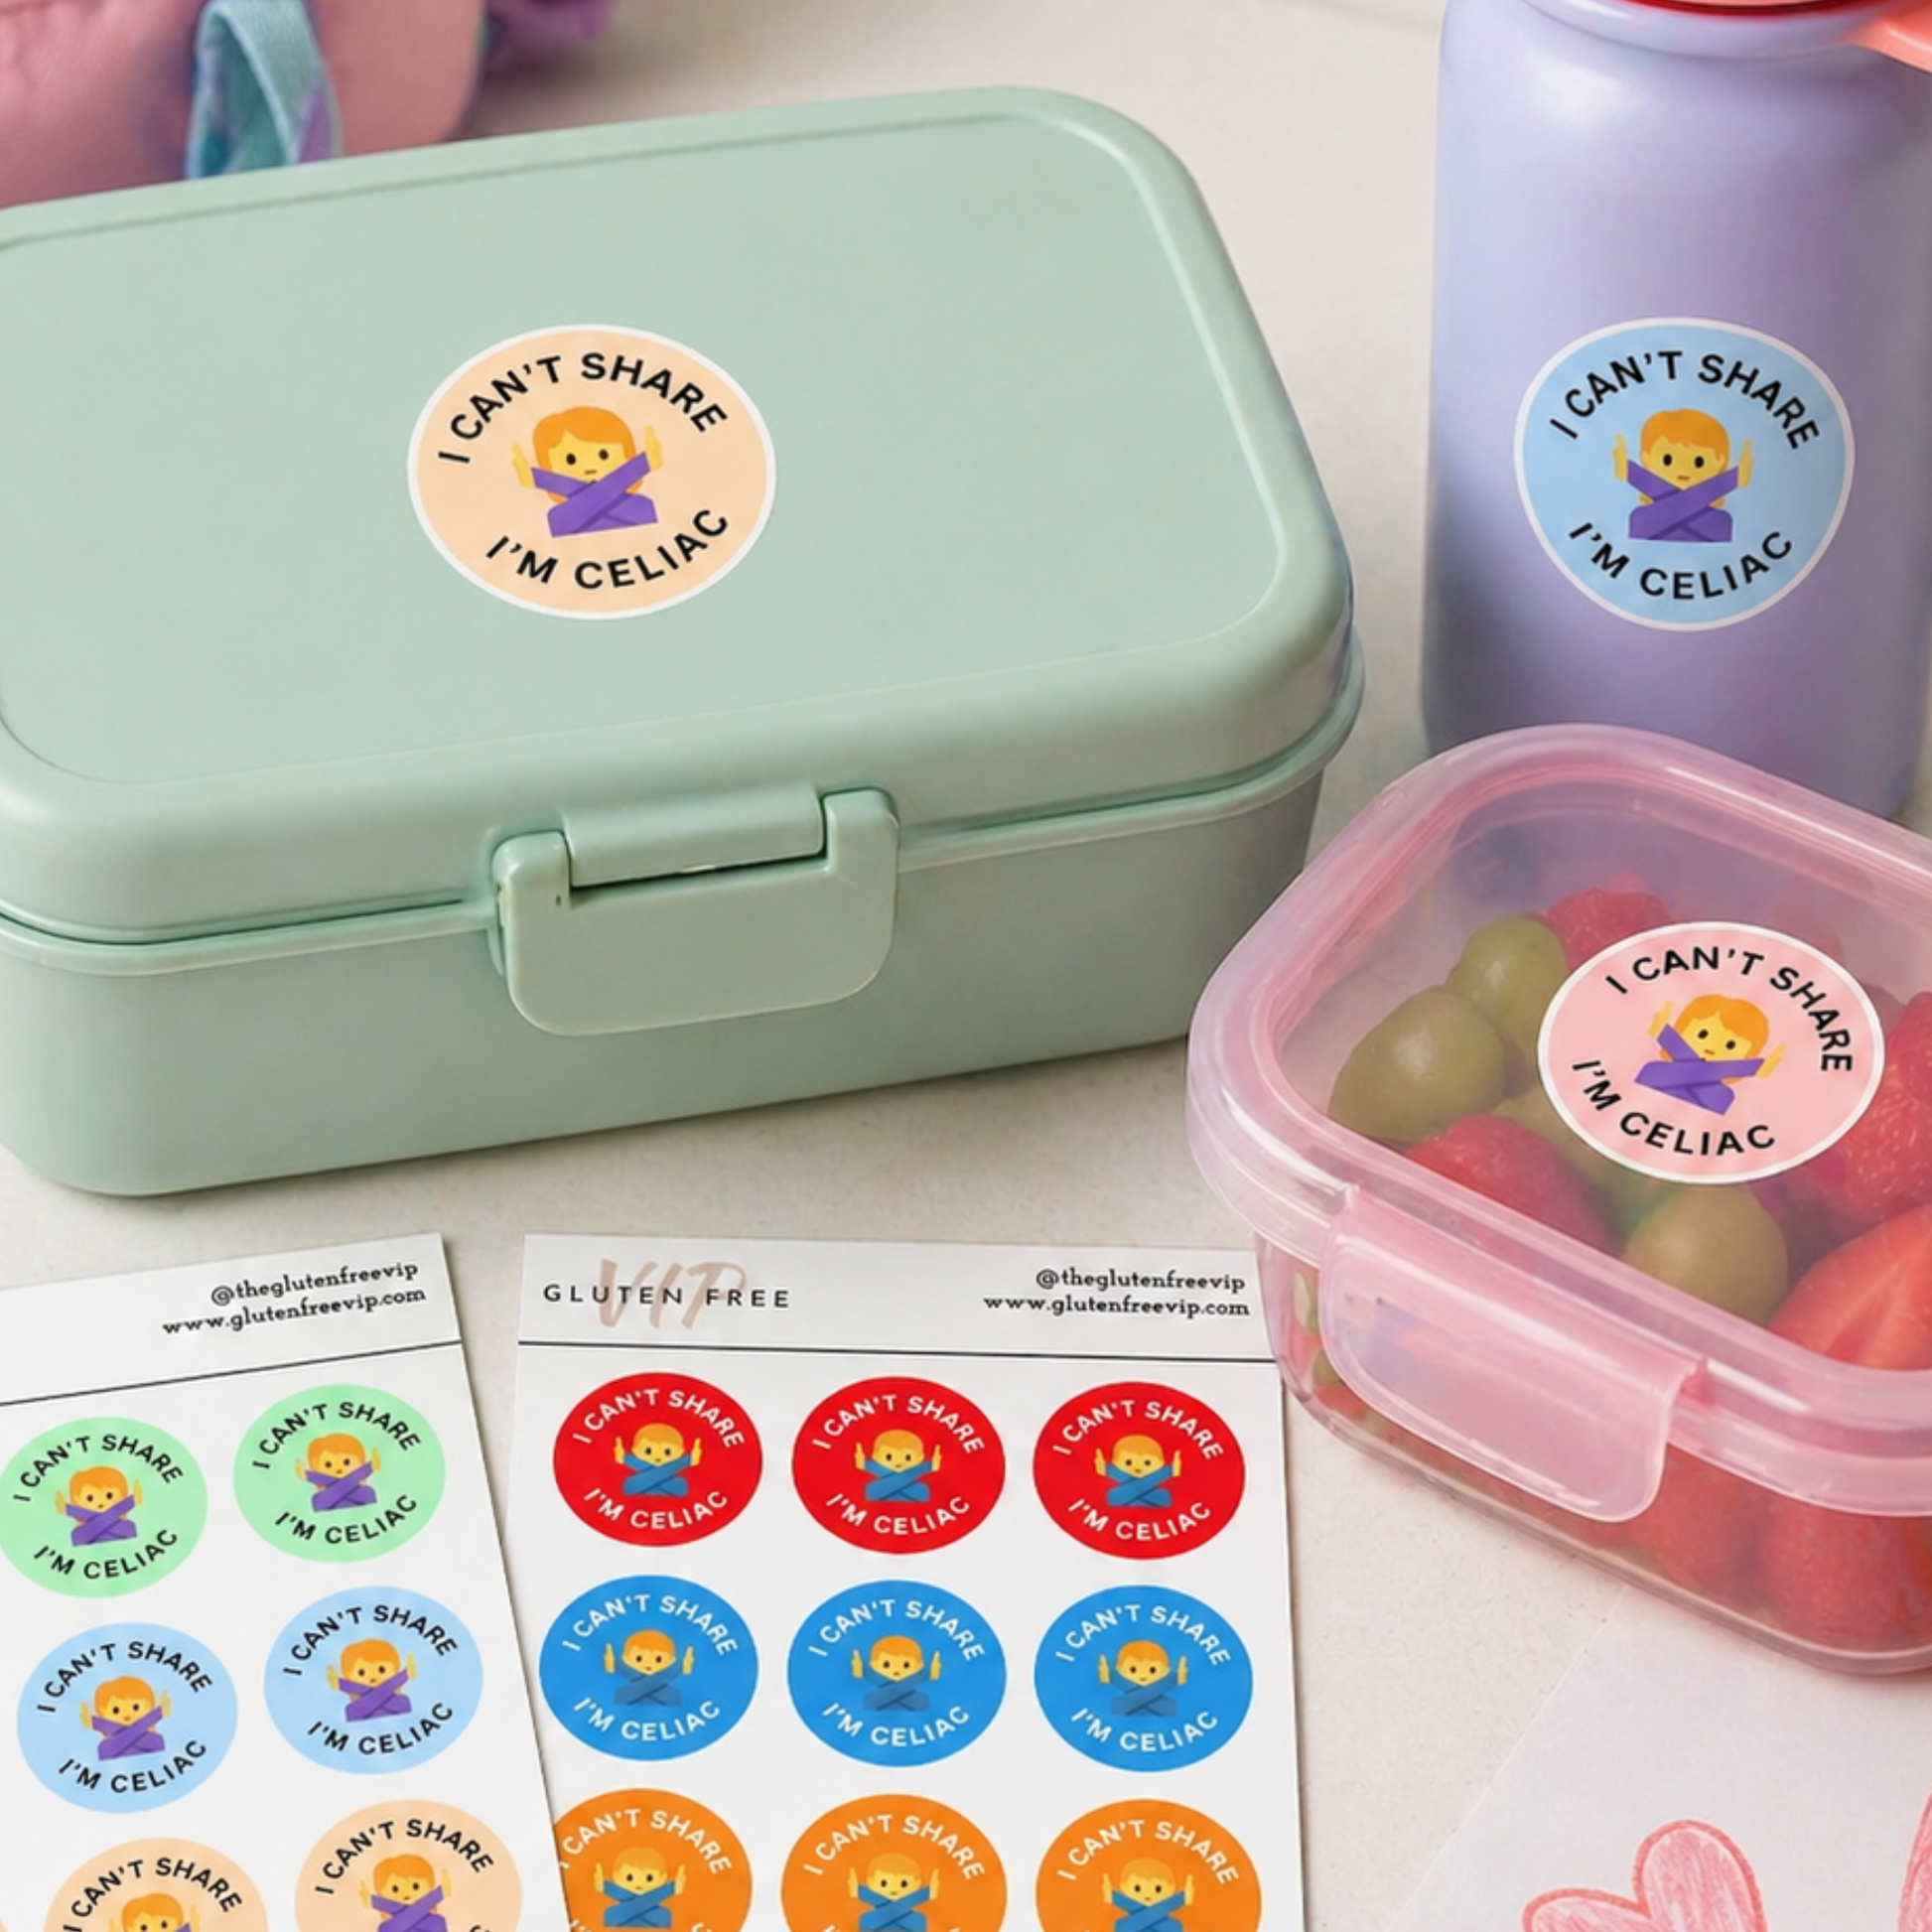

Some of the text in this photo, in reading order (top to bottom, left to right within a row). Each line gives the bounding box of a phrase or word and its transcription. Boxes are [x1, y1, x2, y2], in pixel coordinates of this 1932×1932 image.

[438, 352, 728, 464] I CAN'T SHARE
[1550, 350, 1820, 450] I CAN'T SHARE
[486, 509, 728, 590] I'M CELIAC
[1569, 522, 1792, 600] I'M CELIAC
[1605, 946, 1853, 1071] I CAN'T SHARE
[1573, 1060, 1774, 1156] I'M CELIAC
[211, 1261, 419, 1308] @theglutenfreevip
[543, 1283, 790, 1309] GLUTEN FREE
[599, 1258, 748, 1329] VIP
[983, 1294, 1250, 1319] www.glutenfreevip.com
[1035, 1266, 1246, 1294] @theglutenfreevip
[162, 1288, 427, 1334] www.glutenfreevip.com
[252, 1402, 421, 1469] I CAN'T SHARE
[573, 1388, 745, 1448] I CAN'T SHARE
[812, 1394, 985, 1453] I CAN'T SHARE
[1052, 1400, 1223, 1458] I CAN'T SHARE
[20, 1436, 89, 1487] CAN'T
[101, 1435, 183, 1483] SHARE
[275, 1495, 417, 1544] I'M CELIAC
[584, 1488, 728, 1530] I'M CELIAC
[826, 1493, 970, 1536] I'M CELIAC
[1068, 1498, 1211, 1541] I'M CELIAC
[34, 1530, 178, 1580] I'M CELIAC
[291, 1606, 361, 1660] CAN'T
[373, 1604, 458, 1655] SHARE
[562, 1593, 739, 1655] I CAN'T SHARE
[808, 1598, 985, 1661] I CAN'T SHARE
[1055, 1603, 1231, 1668] I CAN'T SHARE
[45, 1643, 115, 1698] CAN'T
[128, 1641, 212, 1692] SHARE
[308, 1704, 453, 1754] I'M CELIAC
[573, 1697, 720, 1741] I'M CELIAC
[822, 1703, 970, 1747] I'M CELIAC
[1070, 1708, 1218, 1752] I'M CELIAC
[59, 1740, 207, 1793] I'M CELIAC
[323, 1821, 393, 1879] CAN'T
[406, 1819, 493, 1872] SHARE
[563, 1808, 639, 1855] CAN'T
[651, 1810, 732, 1873] SHARE
[804, 1814, 985, 1879] I CAN'T SHARE
[1057, 1820, 1239, 1883] I CAN'T SHARE
[70, 1860, 143, 1917] CAN'T
[155, 1857, 242, 1912] SHARE
